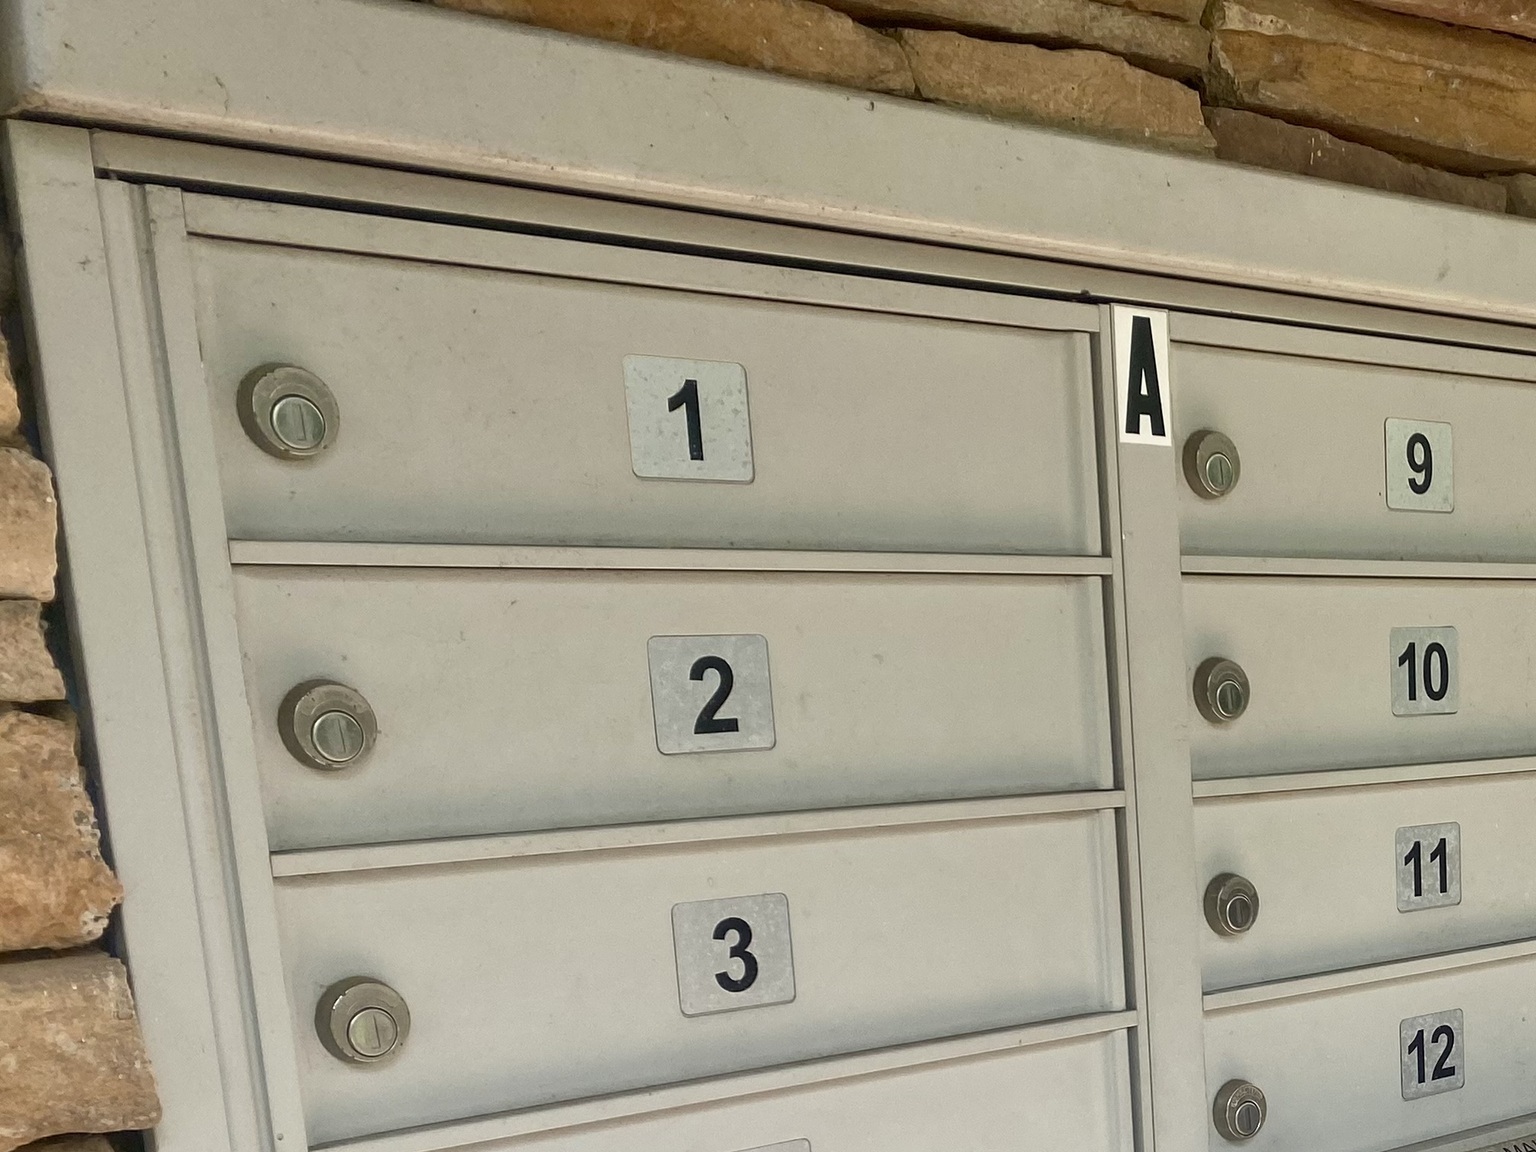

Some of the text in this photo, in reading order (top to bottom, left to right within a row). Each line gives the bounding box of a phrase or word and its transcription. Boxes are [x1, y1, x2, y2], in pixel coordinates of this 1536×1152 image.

[1125, 315, 1166, 437] A
[668, 379, 704, 460] 1
[1407, 433, 1432, 494] 9
[690, 656, 739, 734] 2
[1399, 642, 1448, 701] 10
[1405, 838, 1447, 897] 11
[713, 917, 758, 992] 3
[1408, 1025, 1455, 1084] 12
